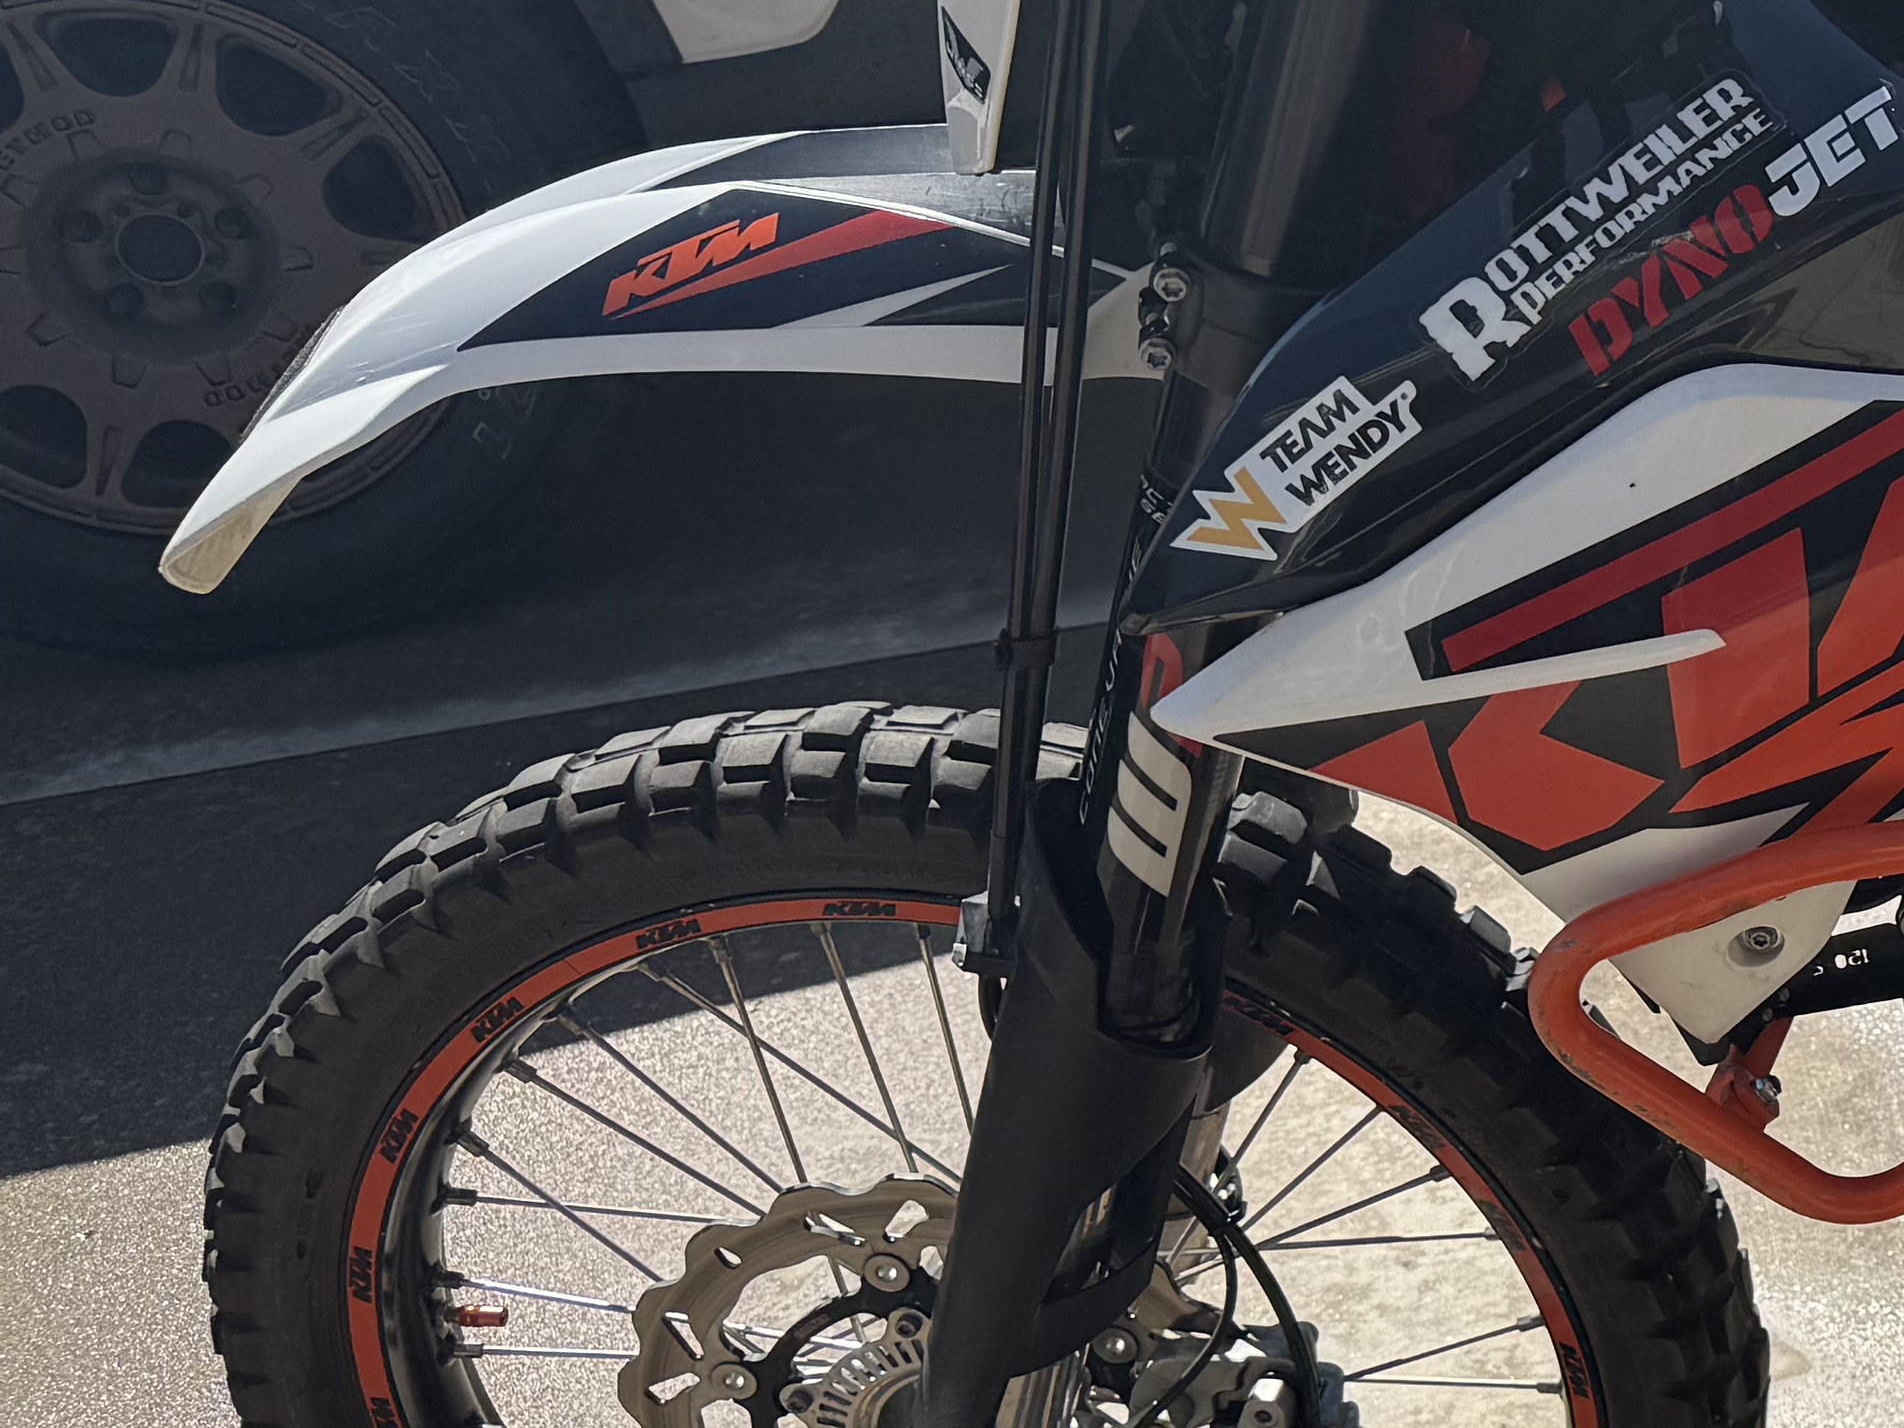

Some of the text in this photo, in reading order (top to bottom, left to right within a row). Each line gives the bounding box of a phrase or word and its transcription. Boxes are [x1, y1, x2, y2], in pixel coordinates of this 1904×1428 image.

[603, 212, 781, 317] KTM
[1418, 77, 1756, 382] ROTTWEILER
[1519, 107, 1773, 324] PERFORMANCE
[1568, 85, 1899, 376] DYNOJET
[1261, 387, 1359, 473] TEAM
[1285, 402, 1409, 509] WENDY
[636, 918, 702, 950] KTM
[471, 995, 525, 1043] KTM
[379, 1108, 418, 1164] KTM
